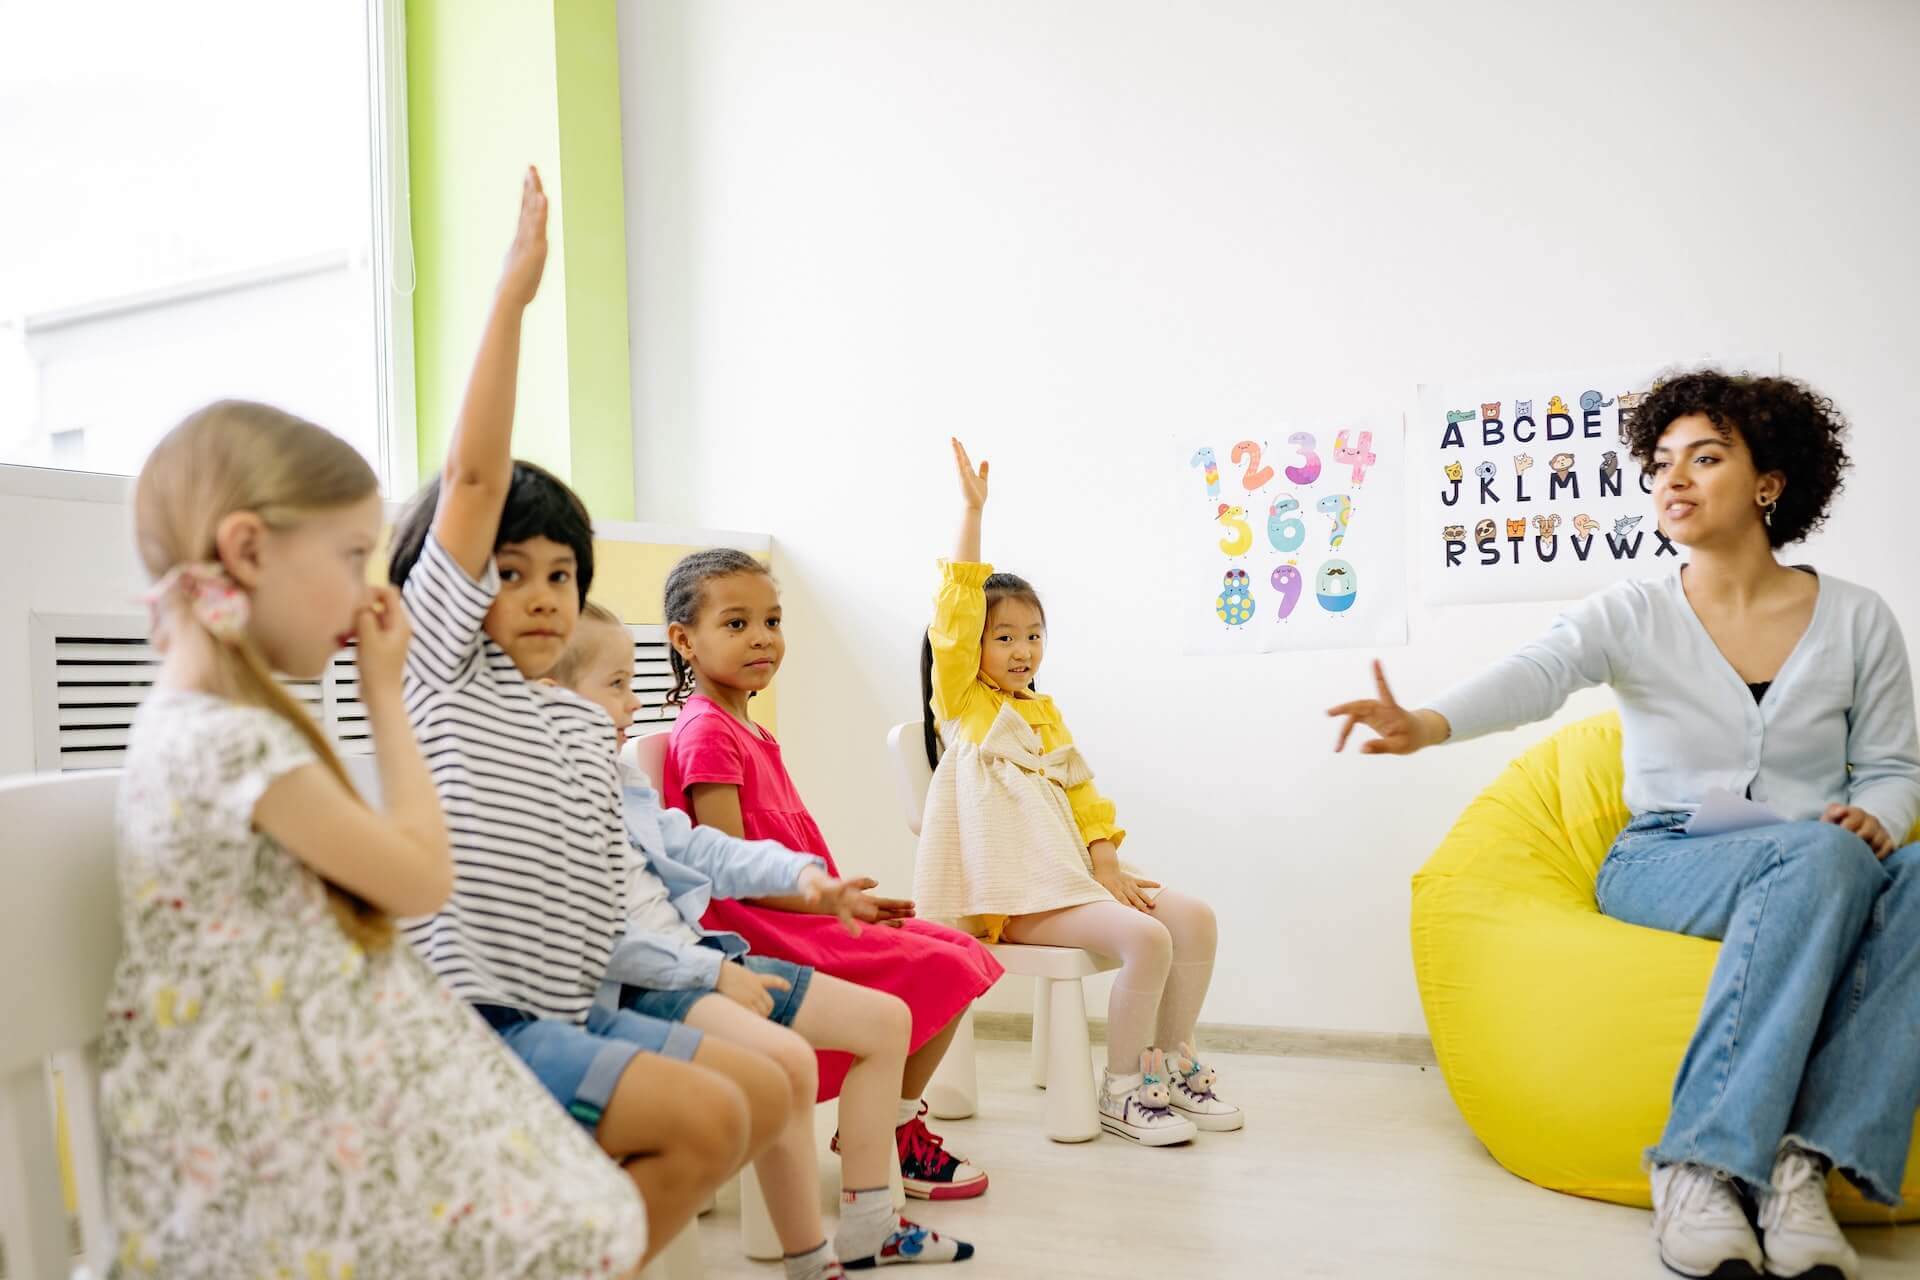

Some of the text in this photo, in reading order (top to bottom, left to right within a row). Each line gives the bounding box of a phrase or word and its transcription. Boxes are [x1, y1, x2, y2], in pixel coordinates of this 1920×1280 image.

[1440, 422, 1465, 449] A
[1483, 419, 1505, 446] B
[1513, 415, 1536, 443] C
[1546, 413, 1574, 441] D
[1583, 410, 1601, 438] E
[1190, 429, 1376, 496] 1 2 3 4
[1441, 480, 1463, 506] J
[1480, 477, 1500, 504] K
[1516, 475, 1531, 502] L
[1550, 471, 1580, 500] M
[1600, 468, 1622, 497] N
[1217, 494, 1352, 558] 5 6 7
[1446, 530, 1678, 567] R S T U V W X
[1215, 568, 1256, 625] 8
[1270, 564, 1302, 620] 9
